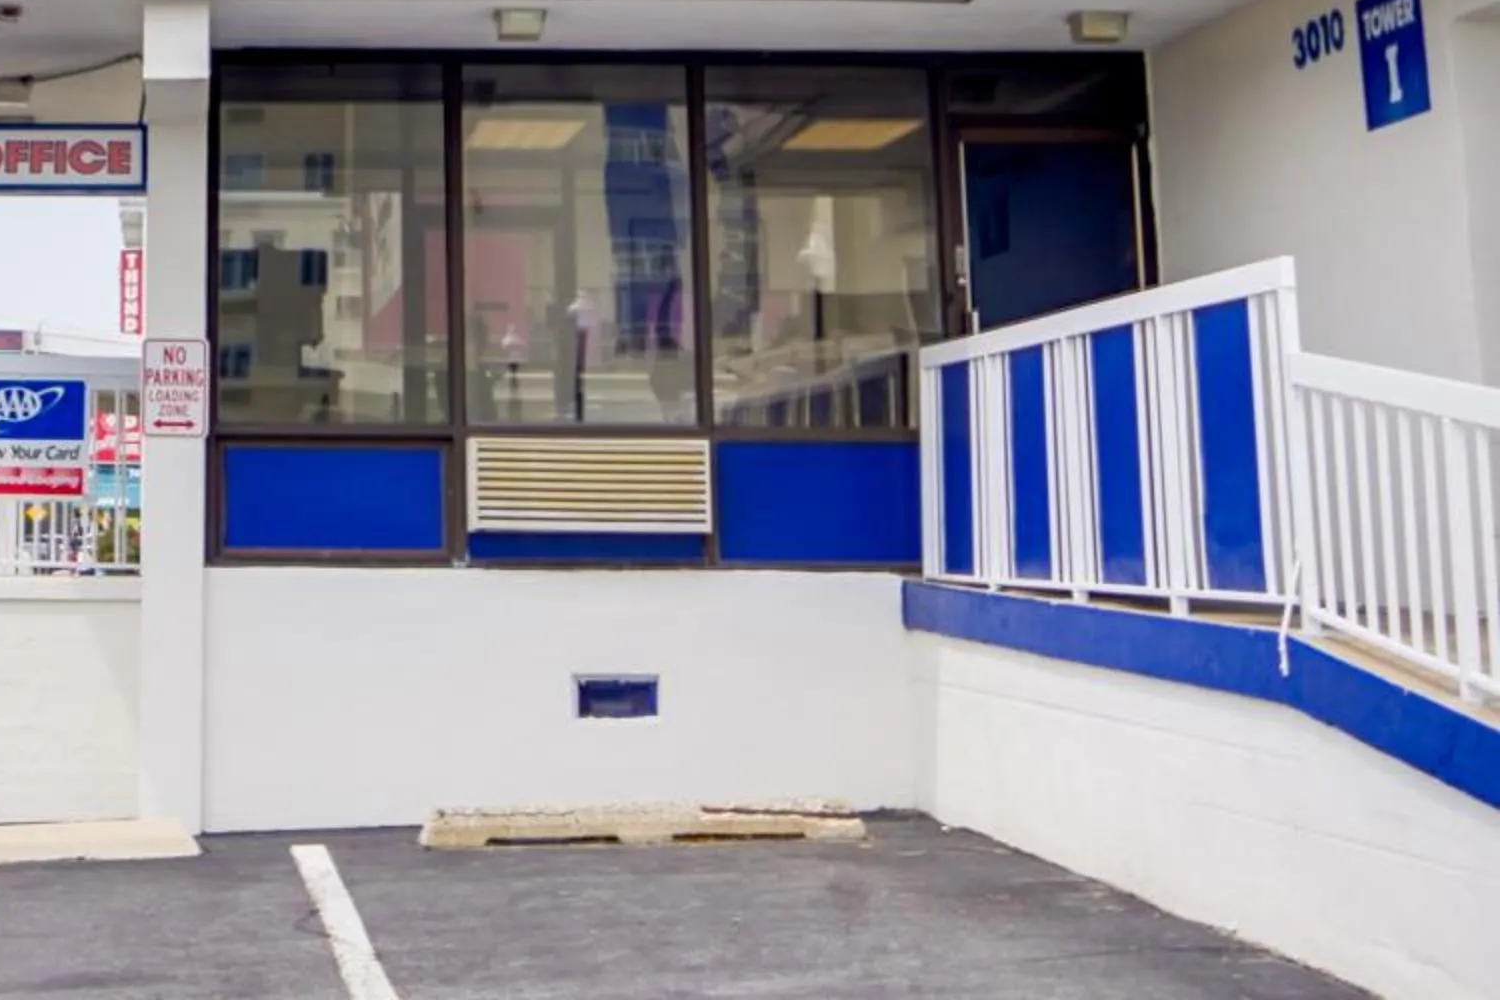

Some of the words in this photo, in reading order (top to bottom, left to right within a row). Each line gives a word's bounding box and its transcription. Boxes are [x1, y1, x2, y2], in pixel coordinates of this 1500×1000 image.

[1292, 9, 1344, 69] 3010
[163, 346, 187, 365] NO
[145, 368, 204, 387] PARKING
[150, 389, 200, 403] LOADING
[159, 404, 188, 417] ZONE
[12, 445, 43, 459] Your
[45, 445, 81, 460] Card
